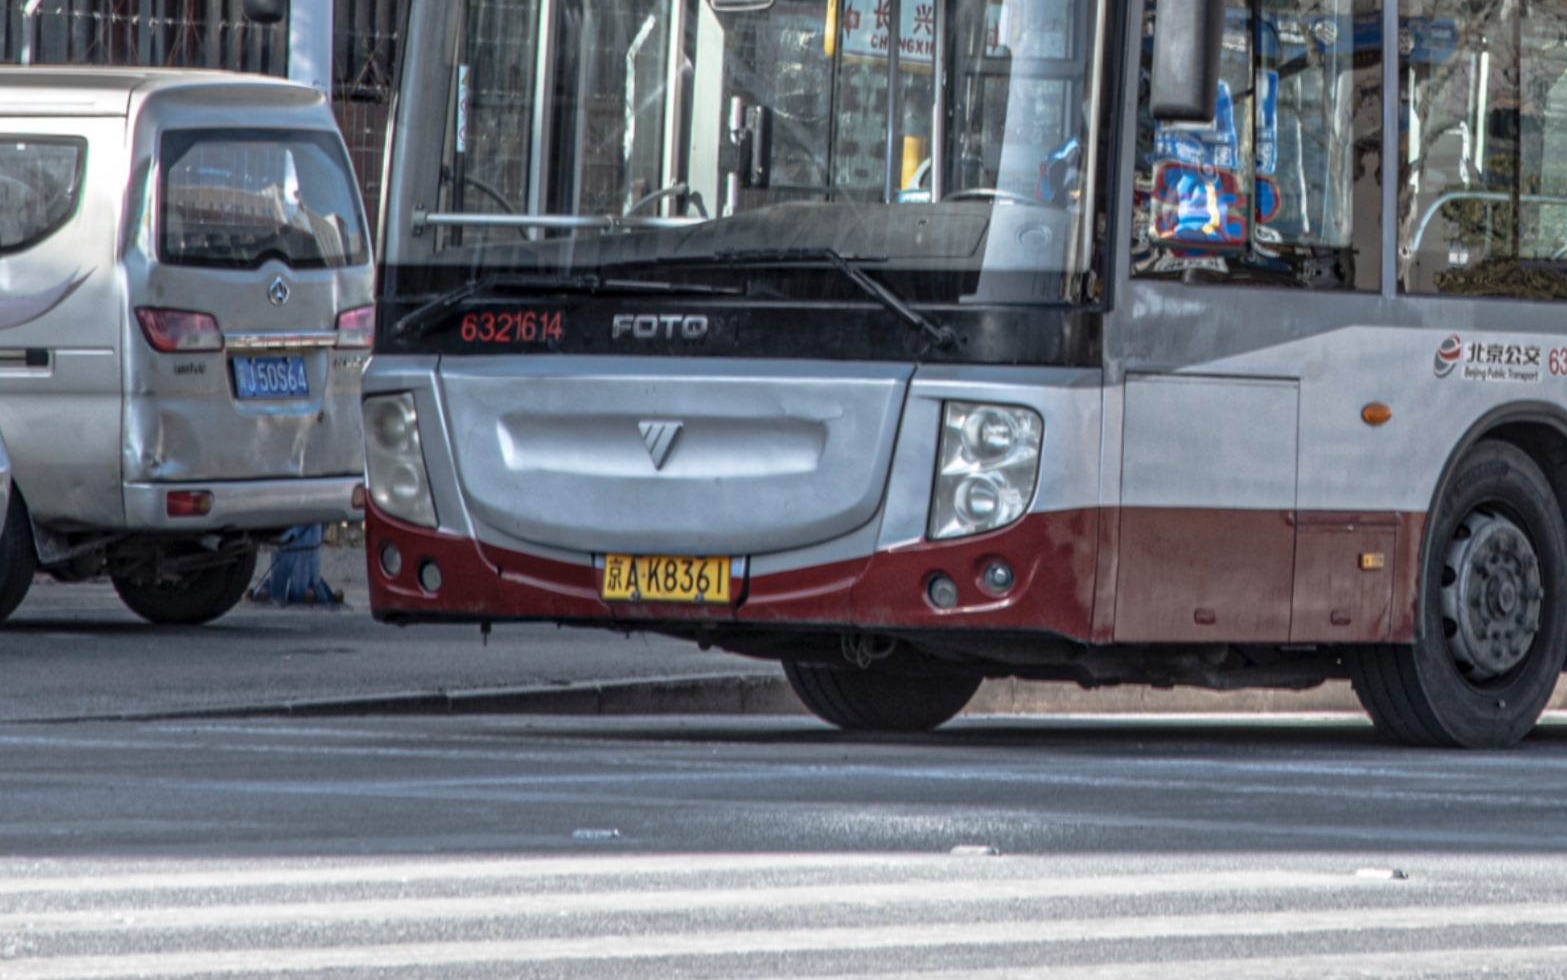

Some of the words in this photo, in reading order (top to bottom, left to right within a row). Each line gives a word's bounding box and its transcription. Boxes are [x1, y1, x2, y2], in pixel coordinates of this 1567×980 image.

[870, 35, 935, 55] CHNGXI
[461, 311, 563, 343] 6321614
[1466, 341, 1541, 365] 北京公交
[1464, 366, 1487, 381] Beijing
[1487, 367, 1506, 380] Public
[1508, 369, 1539, 382] Transport
